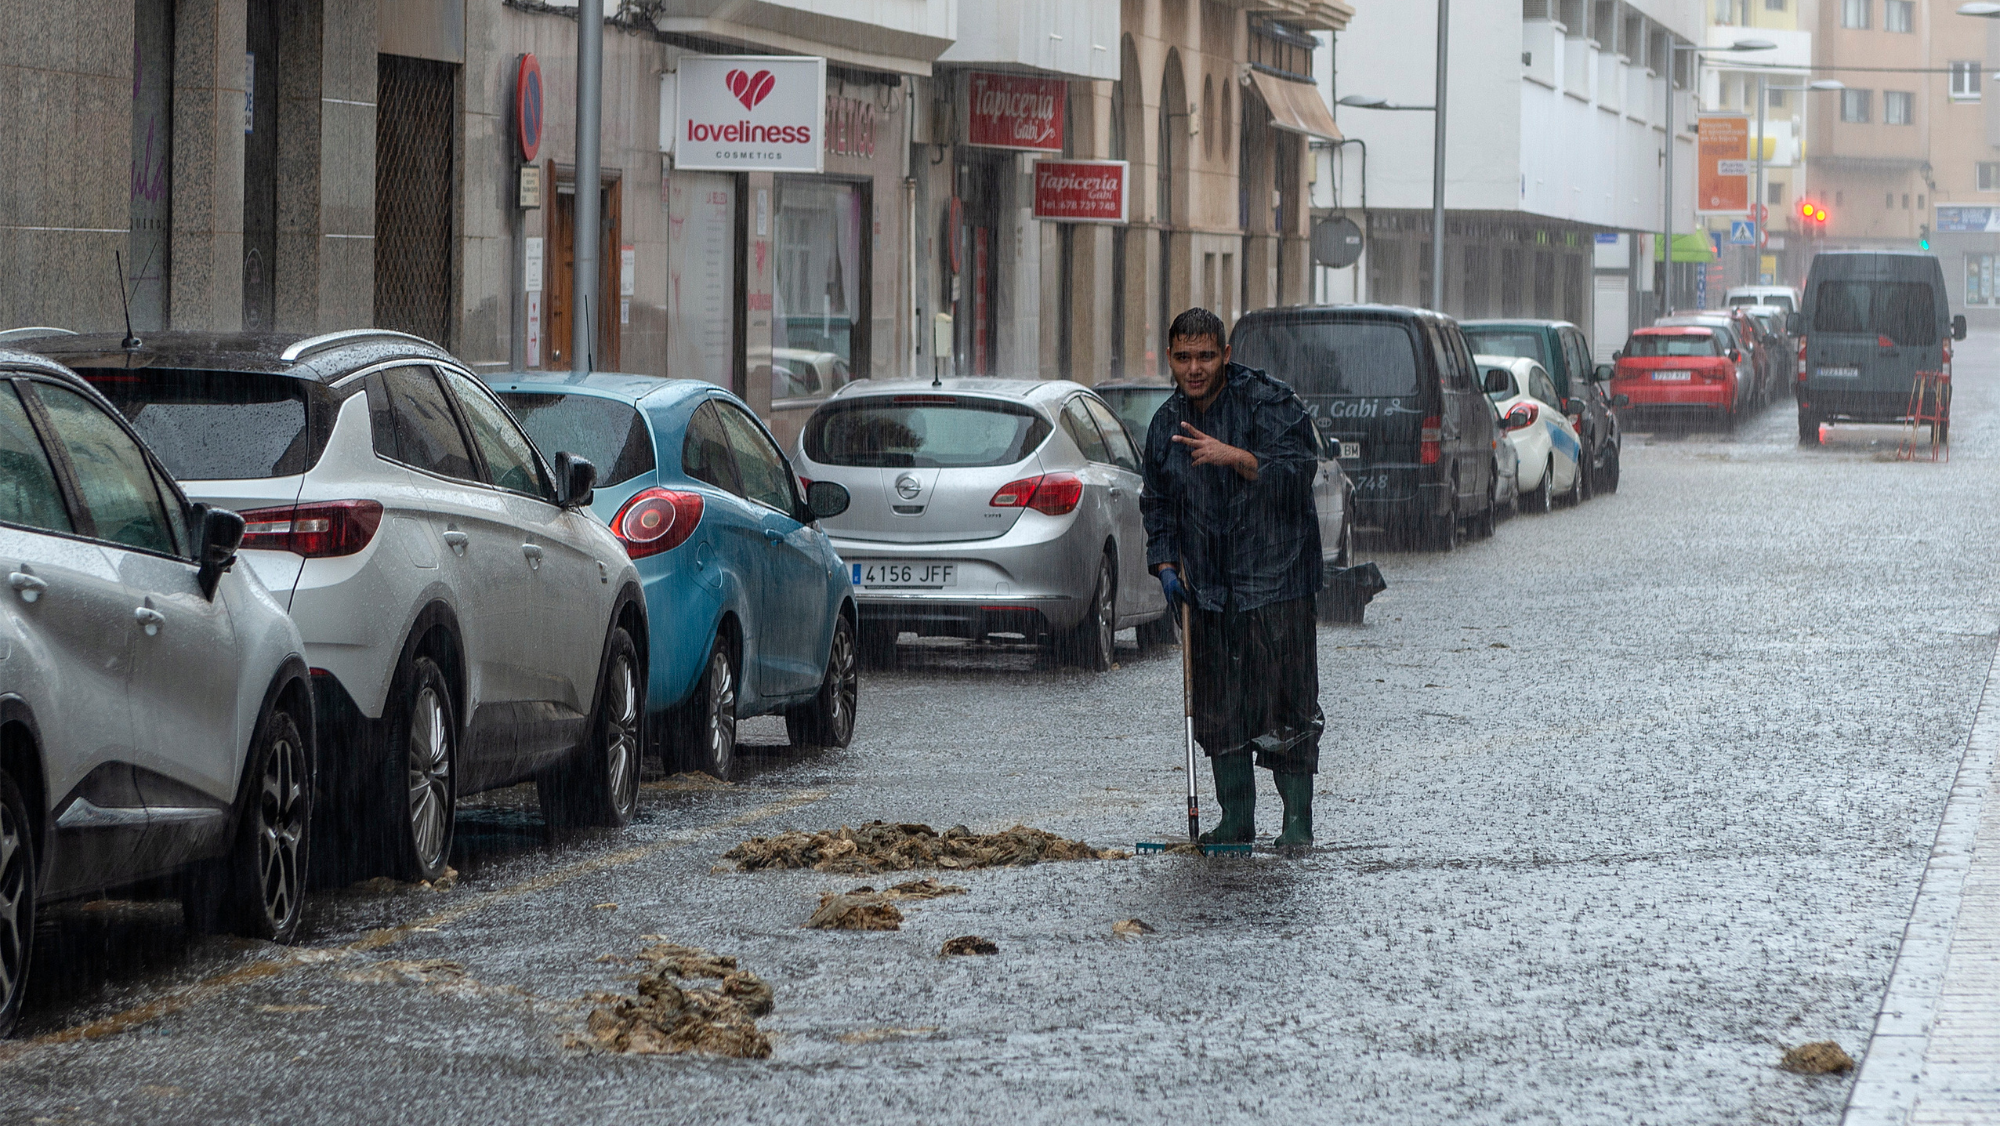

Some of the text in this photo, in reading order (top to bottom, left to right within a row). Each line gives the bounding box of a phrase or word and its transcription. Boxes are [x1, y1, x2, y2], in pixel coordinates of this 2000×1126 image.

[688, 119, 811, 143] loveliness
[1014, 119, 1039, 139] Gabi
[716, 151, 782, 160] COSMETICS
[1040, 171, 1118, 192] Tapicería
[1088, 189, 1112, 200] Gabi
[1099, 201, 1116, 211] 748
[1330, 399, 1378, 418] Gabi
[1344, 444, 1358, 456] BM
[1357, 475, 1388, 491] 748
[866, 566, 953, 582] 4156 JFF
